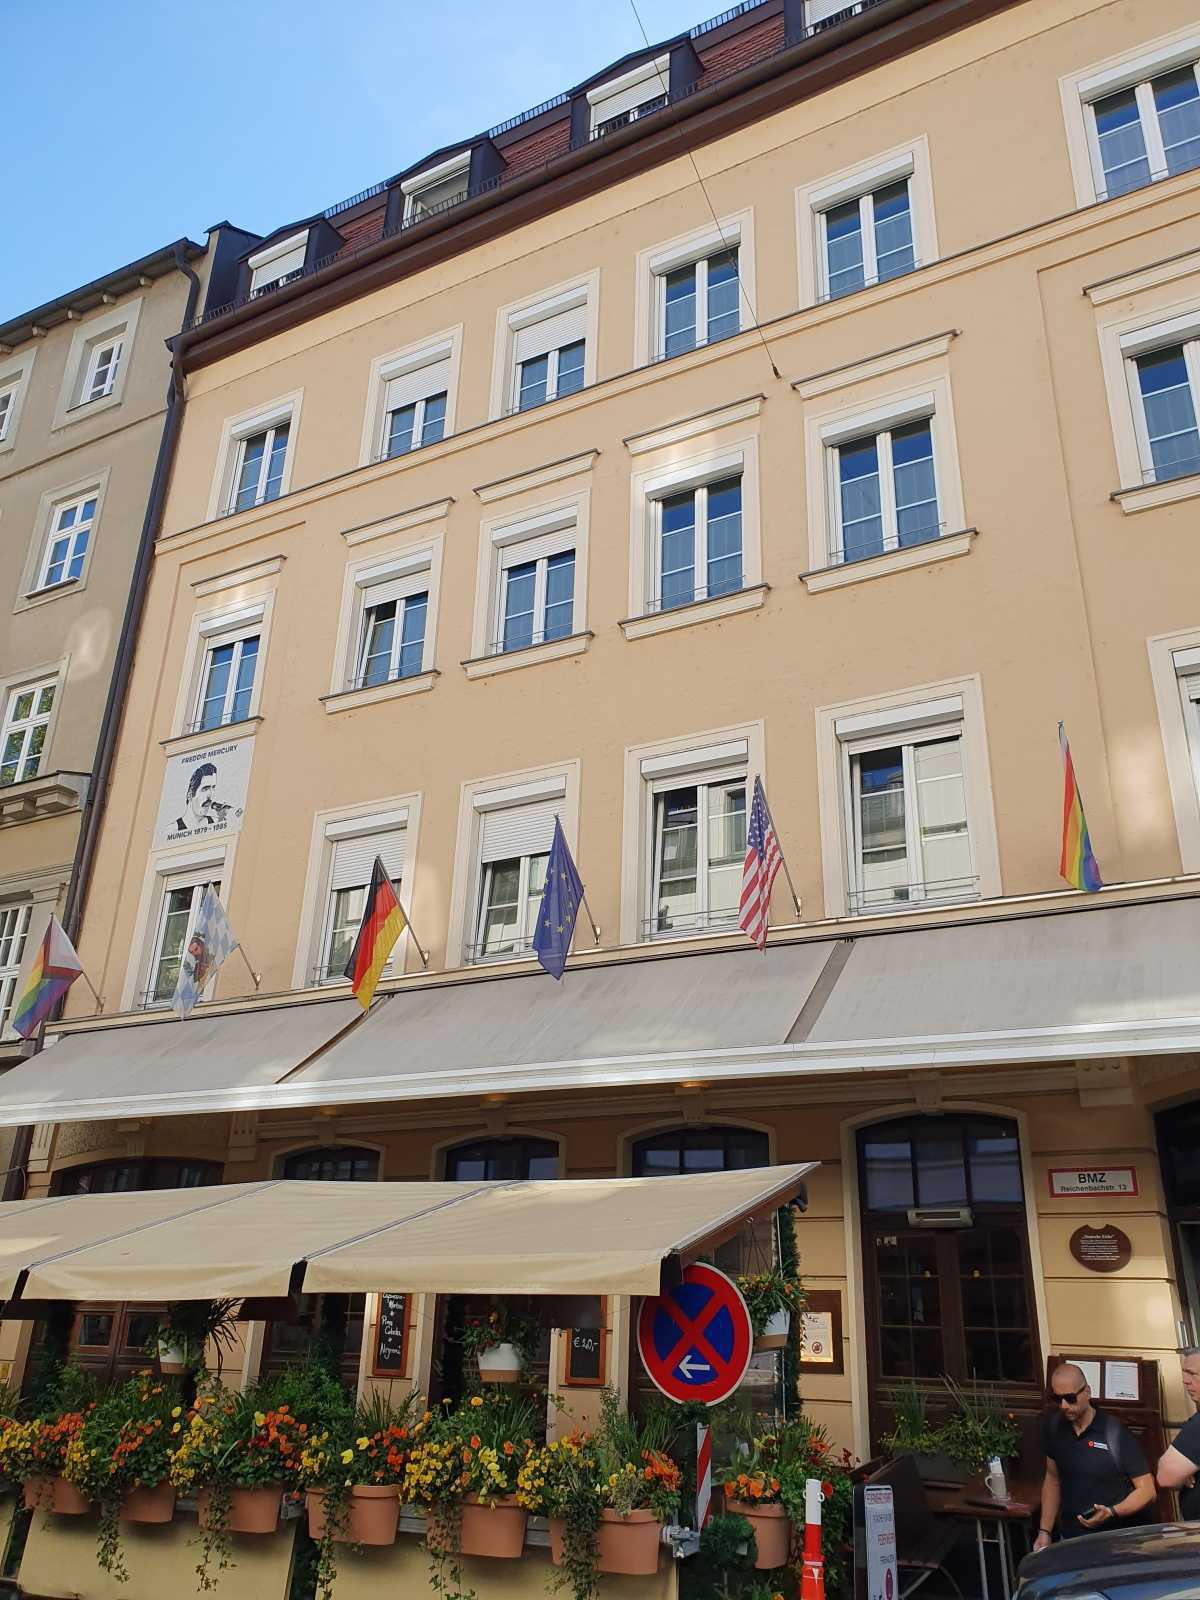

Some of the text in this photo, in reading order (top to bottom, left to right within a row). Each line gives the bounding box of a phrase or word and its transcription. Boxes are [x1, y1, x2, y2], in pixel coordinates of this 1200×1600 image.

[181, 744, 238, 764] FREDDIE MERCURY
[167, 830, 193, 841] MUNICH
[1078, 1173, 1106, 1183] BMZ
